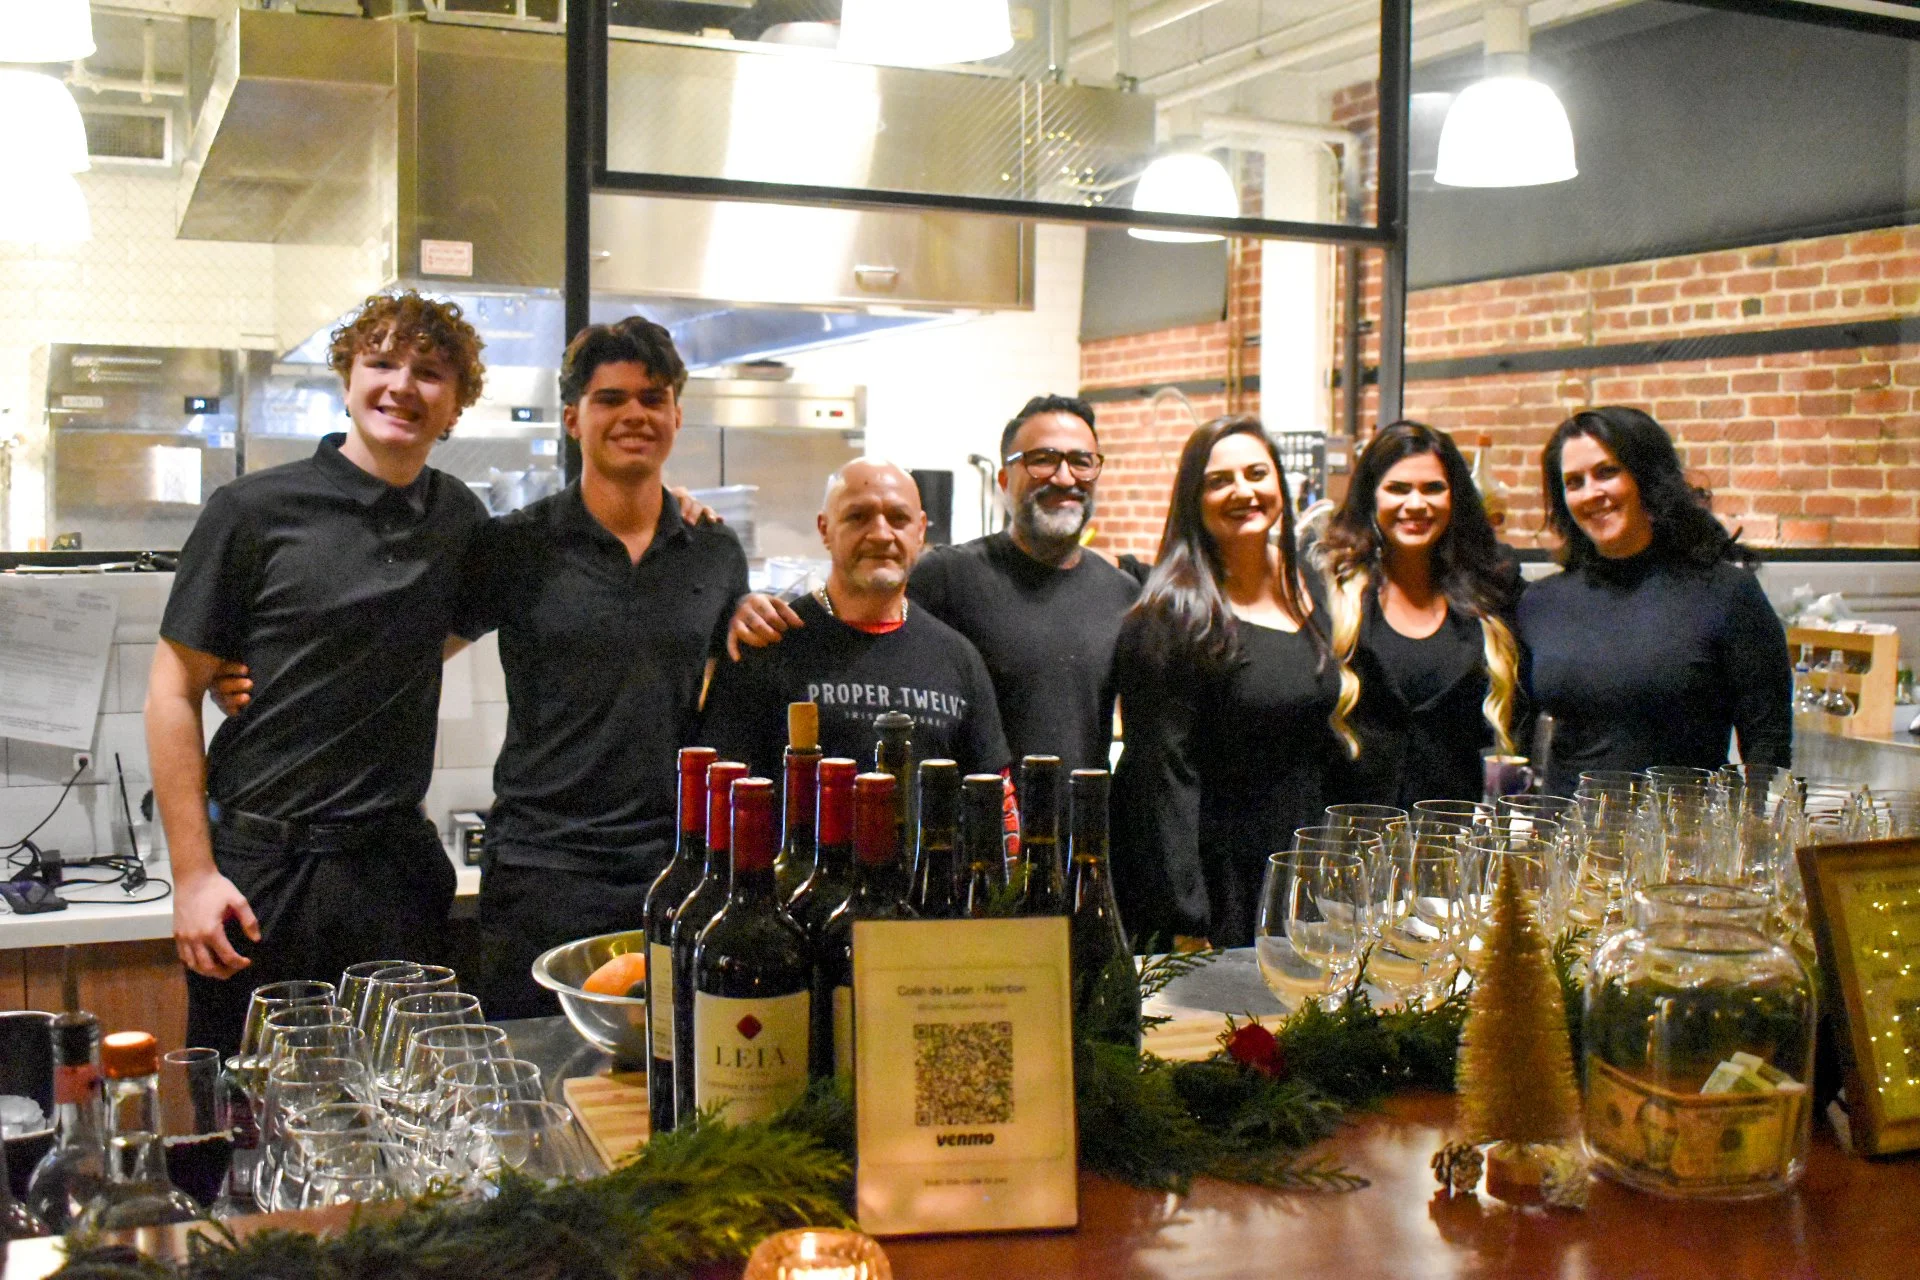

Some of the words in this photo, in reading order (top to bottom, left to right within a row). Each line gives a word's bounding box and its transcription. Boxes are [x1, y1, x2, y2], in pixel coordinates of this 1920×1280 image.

[807, 683, 890, 707] PROPER
[715, 1045, 786, 1069] LEIA
[936, 1132, 995, 1147] venmo
